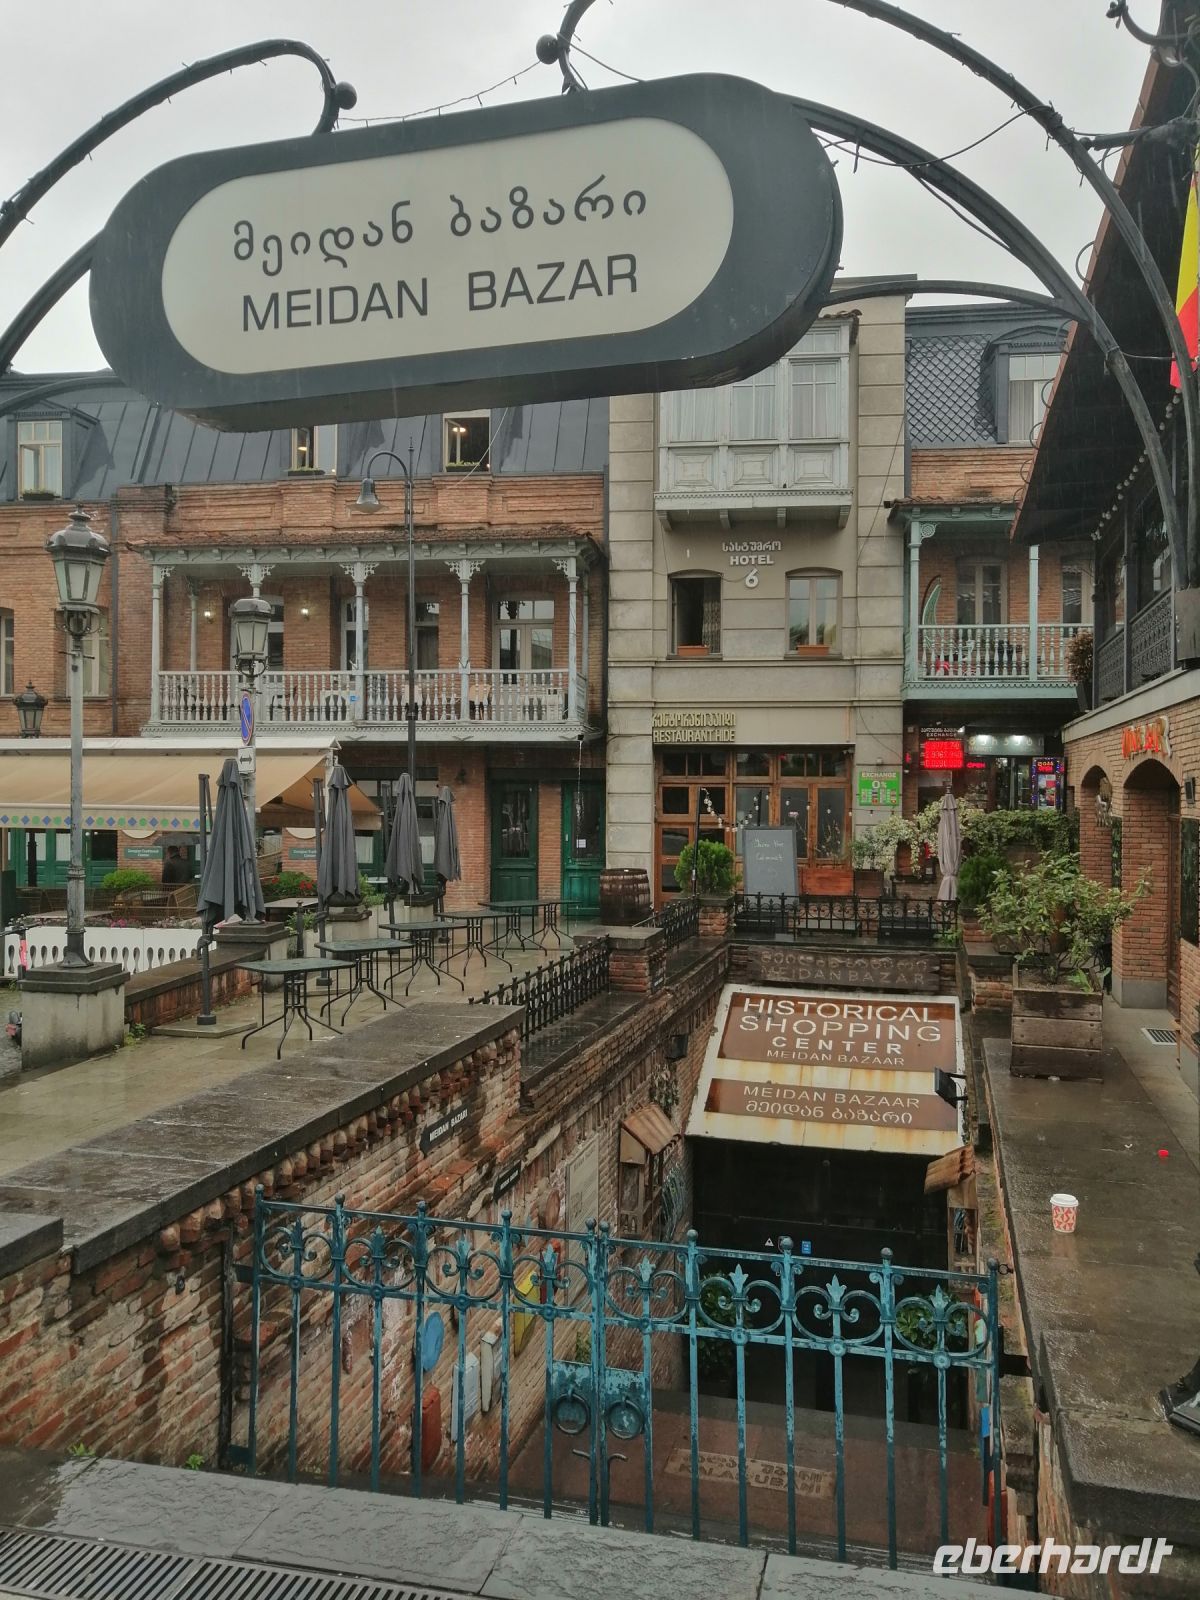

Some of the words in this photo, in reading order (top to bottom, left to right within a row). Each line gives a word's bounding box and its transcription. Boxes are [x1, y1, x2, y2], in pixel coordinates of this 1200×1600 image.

[233, 199, 413, 277] მეიდან
[449, 174, 647, 237] ბაზარი
[243, 277, 428, 332] MEIDAN
[468, 253, 637, 311] BAZAR
[722, 540, 782, 552] სასტუმრო
[729, 554, 774, 566] HOTEL
[745, 568, 759, 588] 6
[653, 729, 714, 742] RESTAURANT
[715, 729, 736, 742] HIDE
[848, 970, 926, 985] BAZAR
[742, 997, 940, 1024] HISTORICAL
[739, 1015, 942, 1042] SHOPPING
[771, 1036, 902, 1055] CENTER
[766, 1050, 832, 1062] MEIDAN
[837, 1054, 905, 1066] BAZAAR
[743, 1085, 826, 1102] MEIDAN
[833, 1093, 920, 1110] BAZAAR
[745, 1100, 824, 1119] მეიდან
[831, 1107, 913, 1125] ბაზარი
[429, 1121, 450, 1142] MEIDAN
